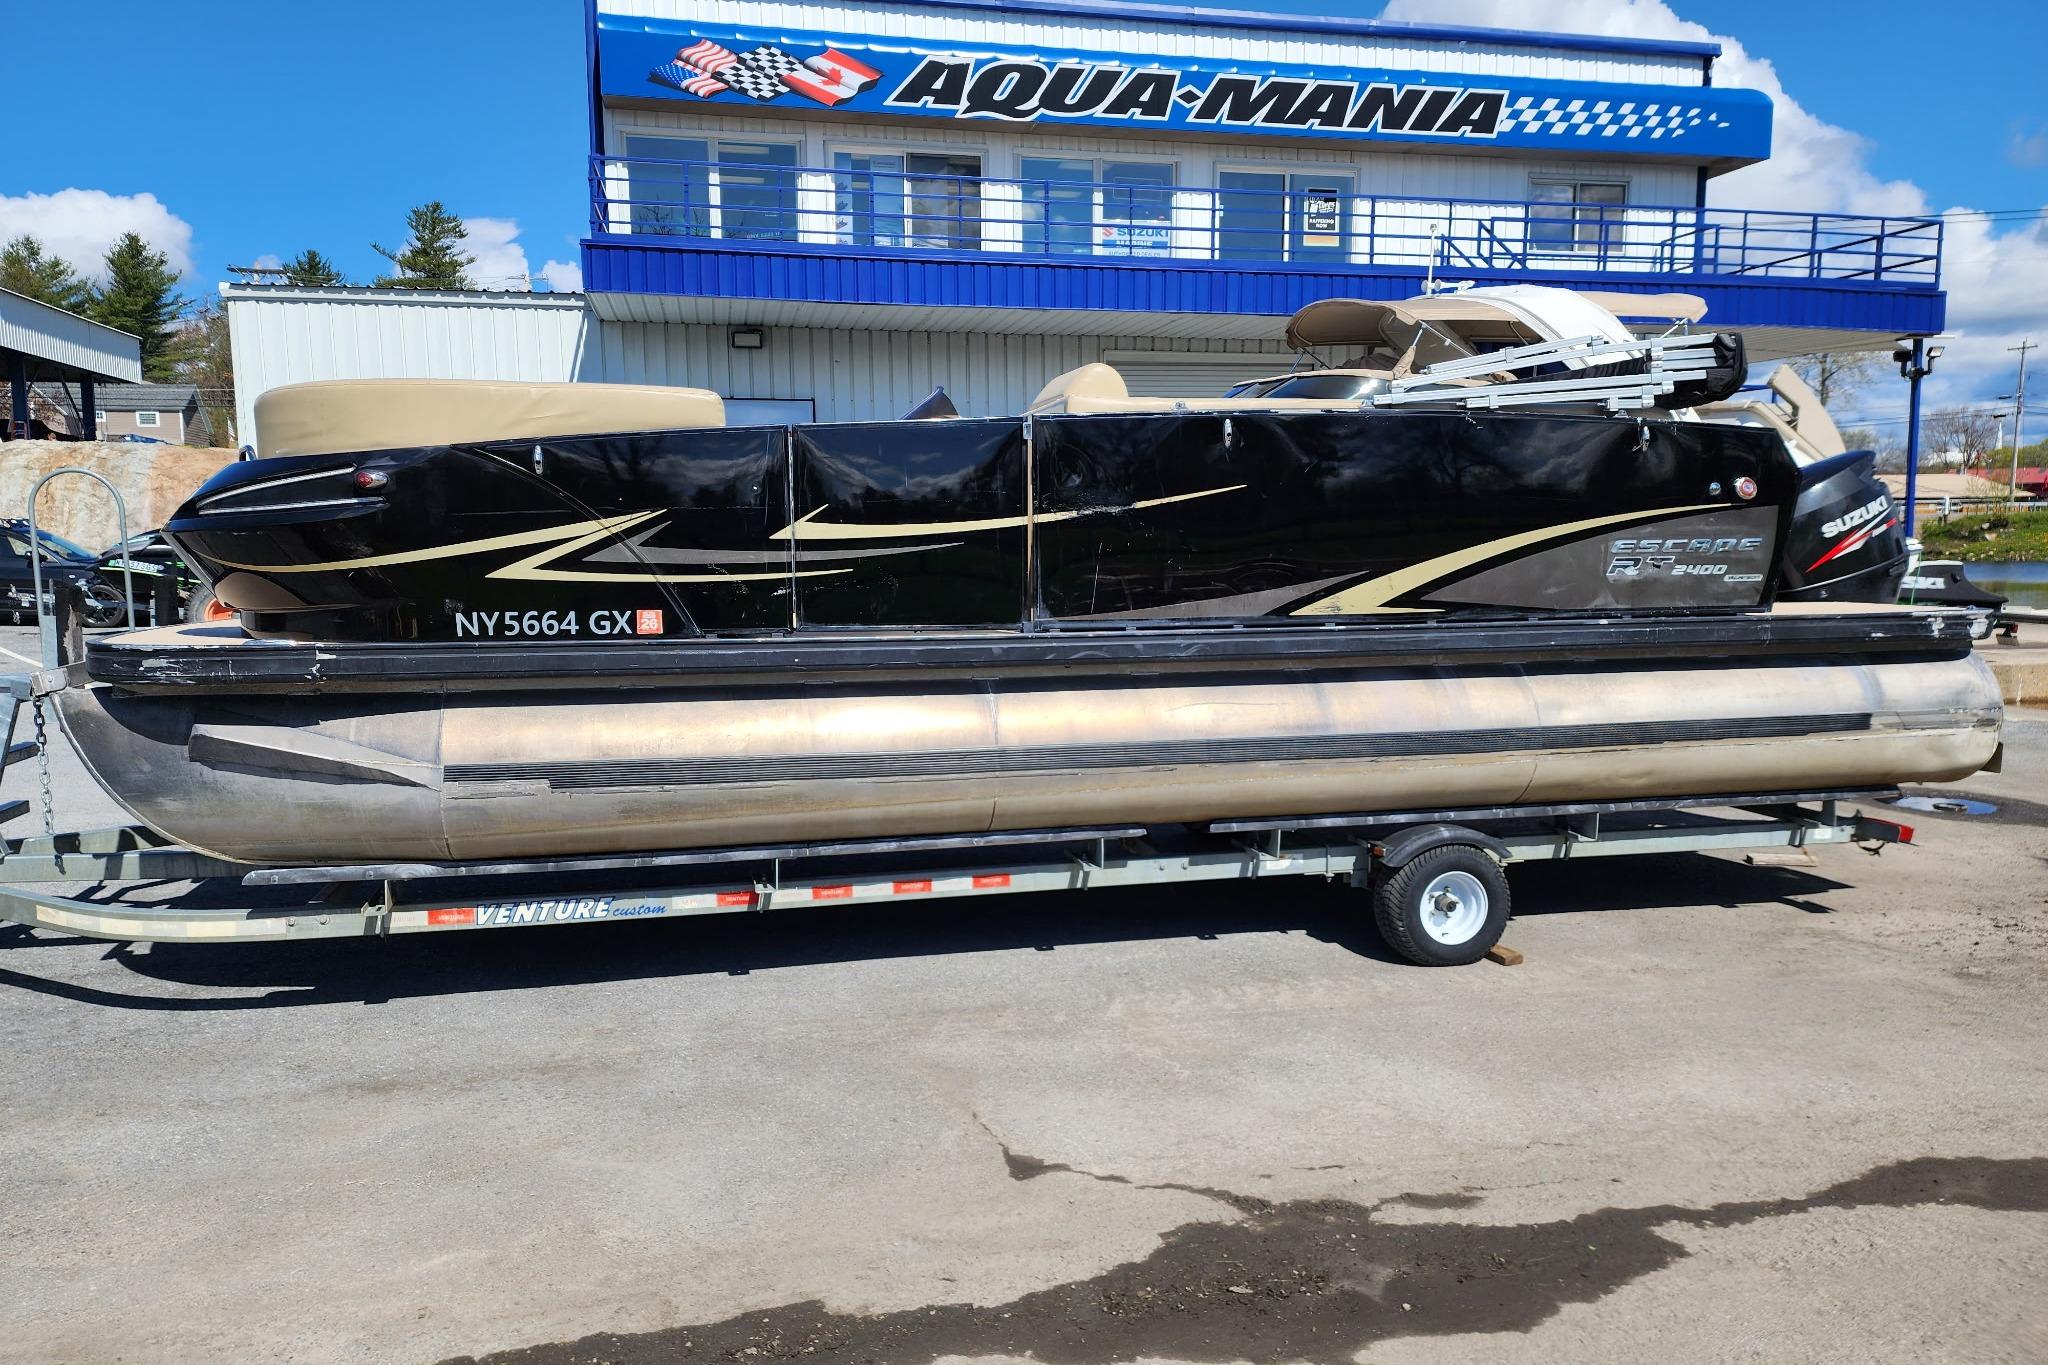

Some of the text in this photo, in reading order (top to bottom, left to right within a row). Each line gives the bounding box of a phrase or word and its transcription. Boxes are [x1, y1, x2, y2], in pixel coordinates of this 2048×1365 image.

[1117, 227, 1168, 238] SUZUKI
[1821, 495, 1888, 538] SUZUKI
[1610, 538, 1762, 555] ESCAPE
[1671, 564, 1728, 576] 2400
[589, 610, 633, 634] GX
[476, 896, 667, 926] VENTURE custom
